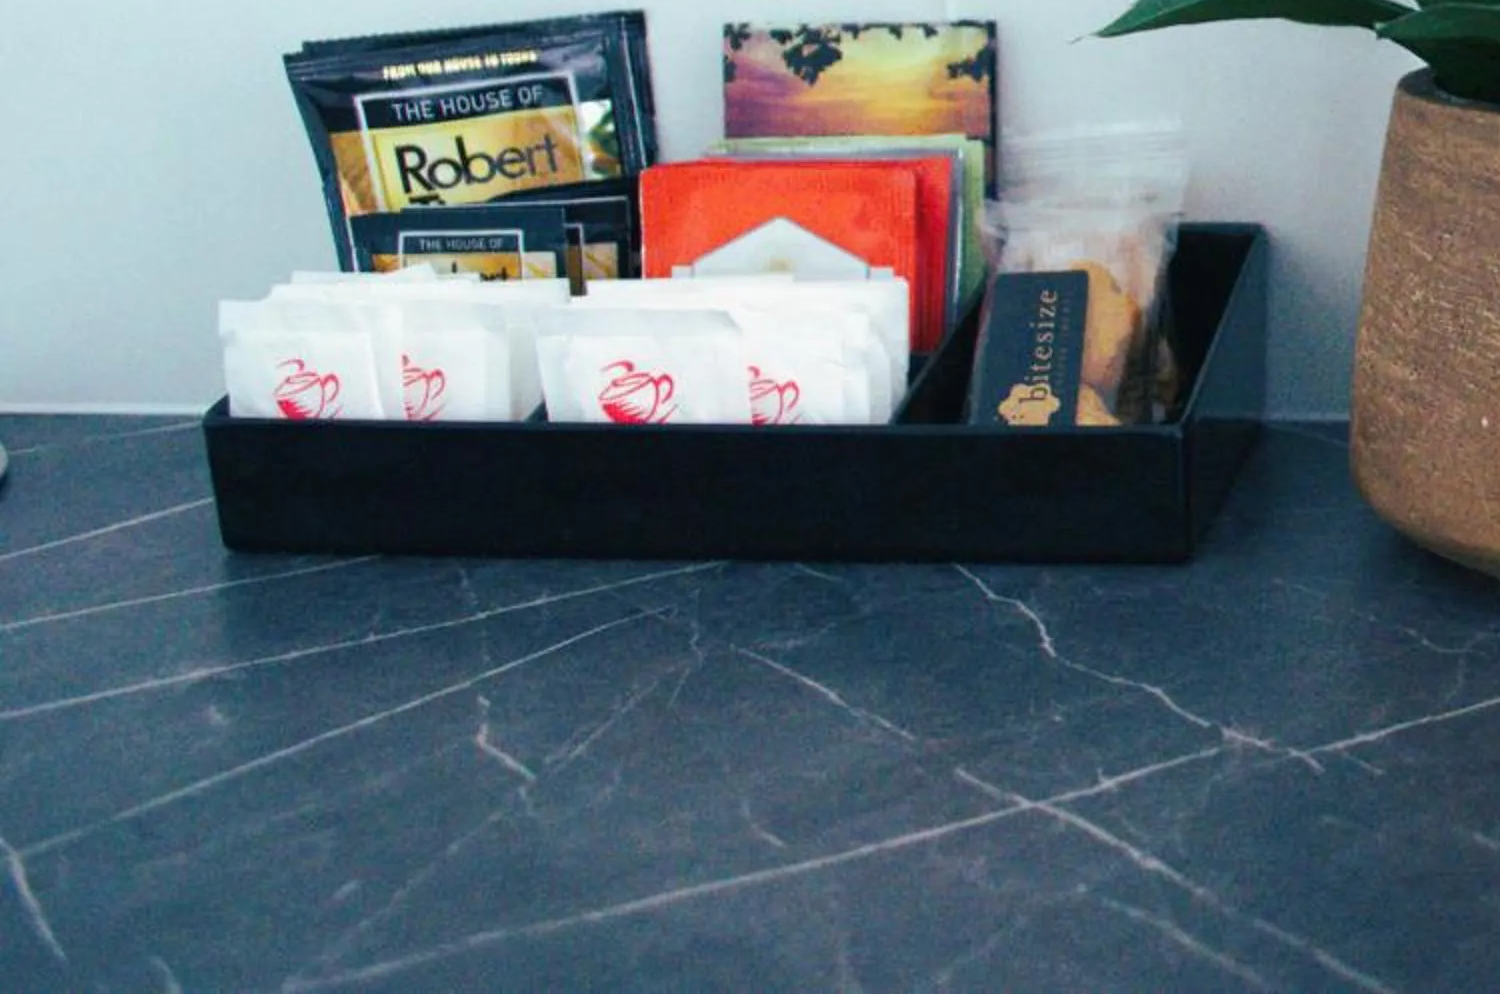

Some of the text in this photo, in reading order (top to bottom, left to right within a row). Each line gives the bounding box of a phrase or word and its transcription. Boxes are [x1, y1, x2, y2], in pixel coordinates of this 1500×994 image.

[392, 84, 543, 121] THE HOUSE OF
[395, 134, 558, 194] Robert
[419, 237, 504, 251] THE HOUSE OF
[1018, 290, 1058, 404] bitesize
